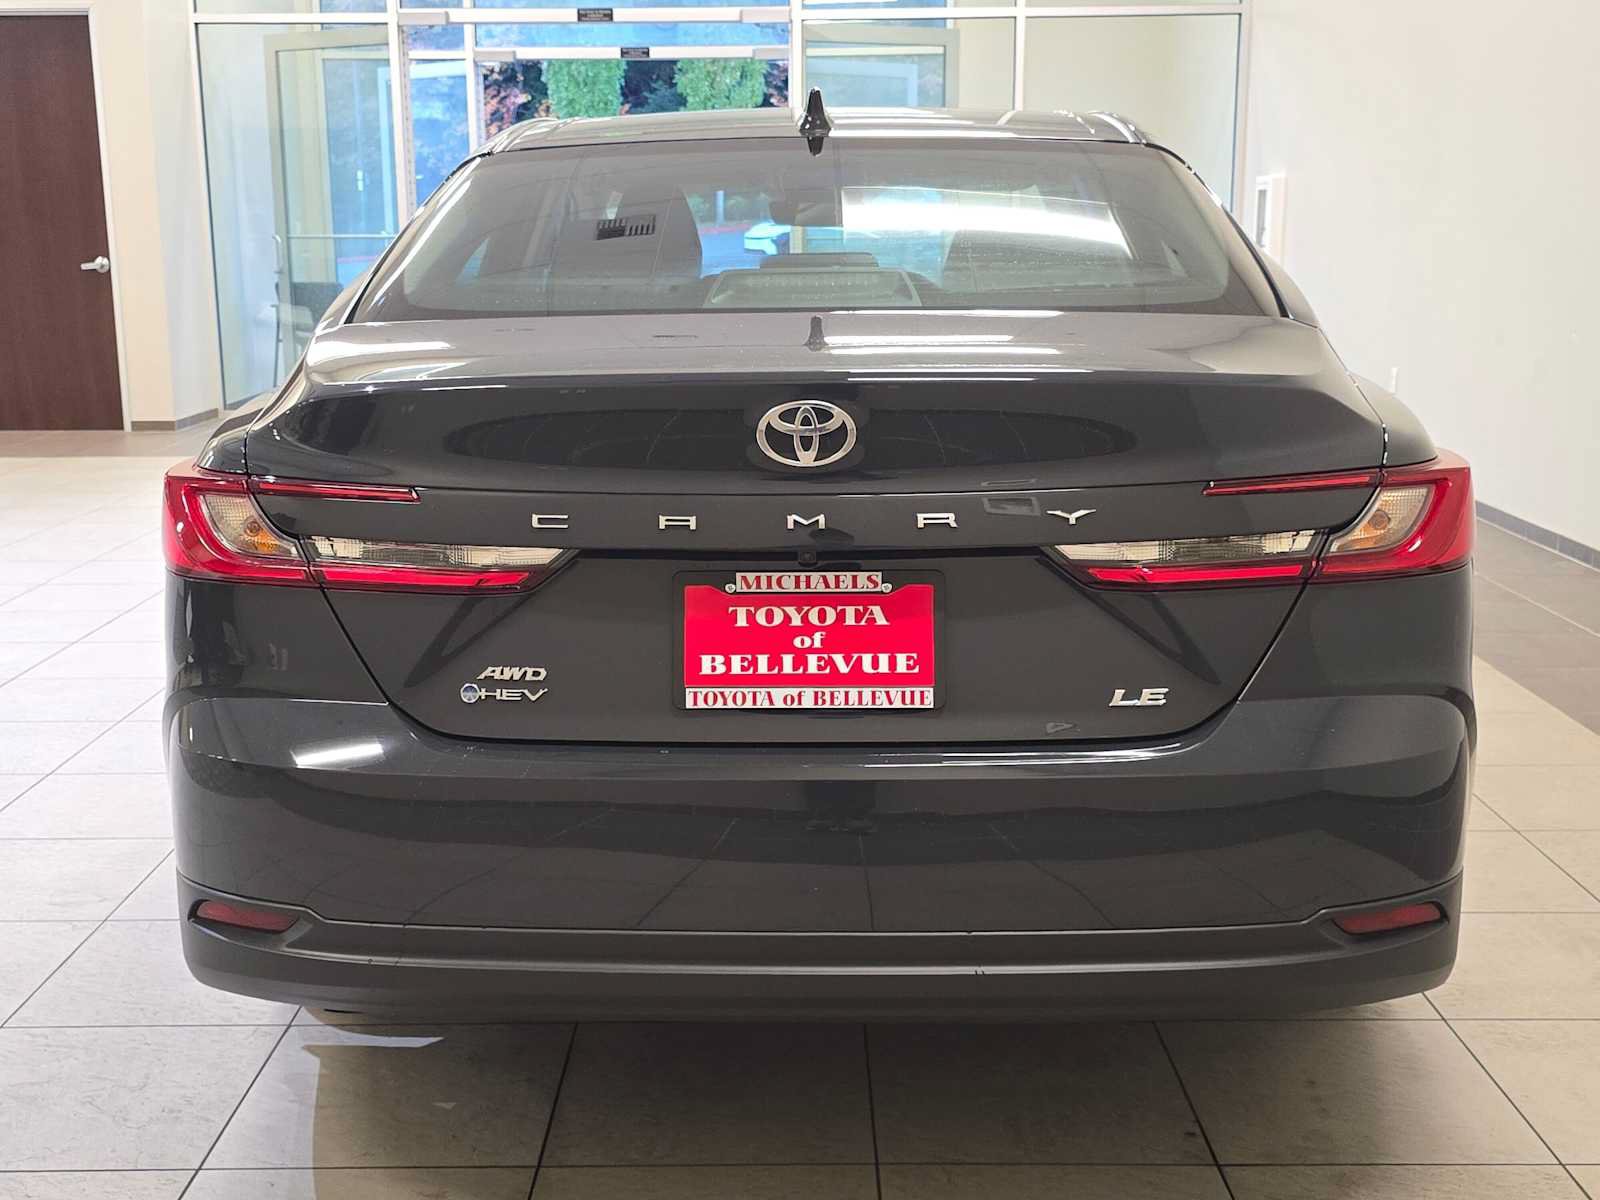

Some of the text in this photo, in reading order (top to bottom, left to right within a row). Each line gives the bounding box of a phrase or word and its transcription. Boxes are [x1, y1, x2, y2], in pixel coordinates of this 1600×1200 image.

[532, 508, 1096, 530] CAMRY
[739, 574, 880, 591] MICHAELS
[728, 605, 890, 627] TOYOTA
[792, 631, 827, 649] of
[698, 652, 920, 675] BELLEVUE
[476, 665, 548, 681] AWD
[480, 687, 549, 702] HEV
[687, 689, 933, 707] TOYOTA of BELLEVUE
[1109, 688, 1169, 706] LE
